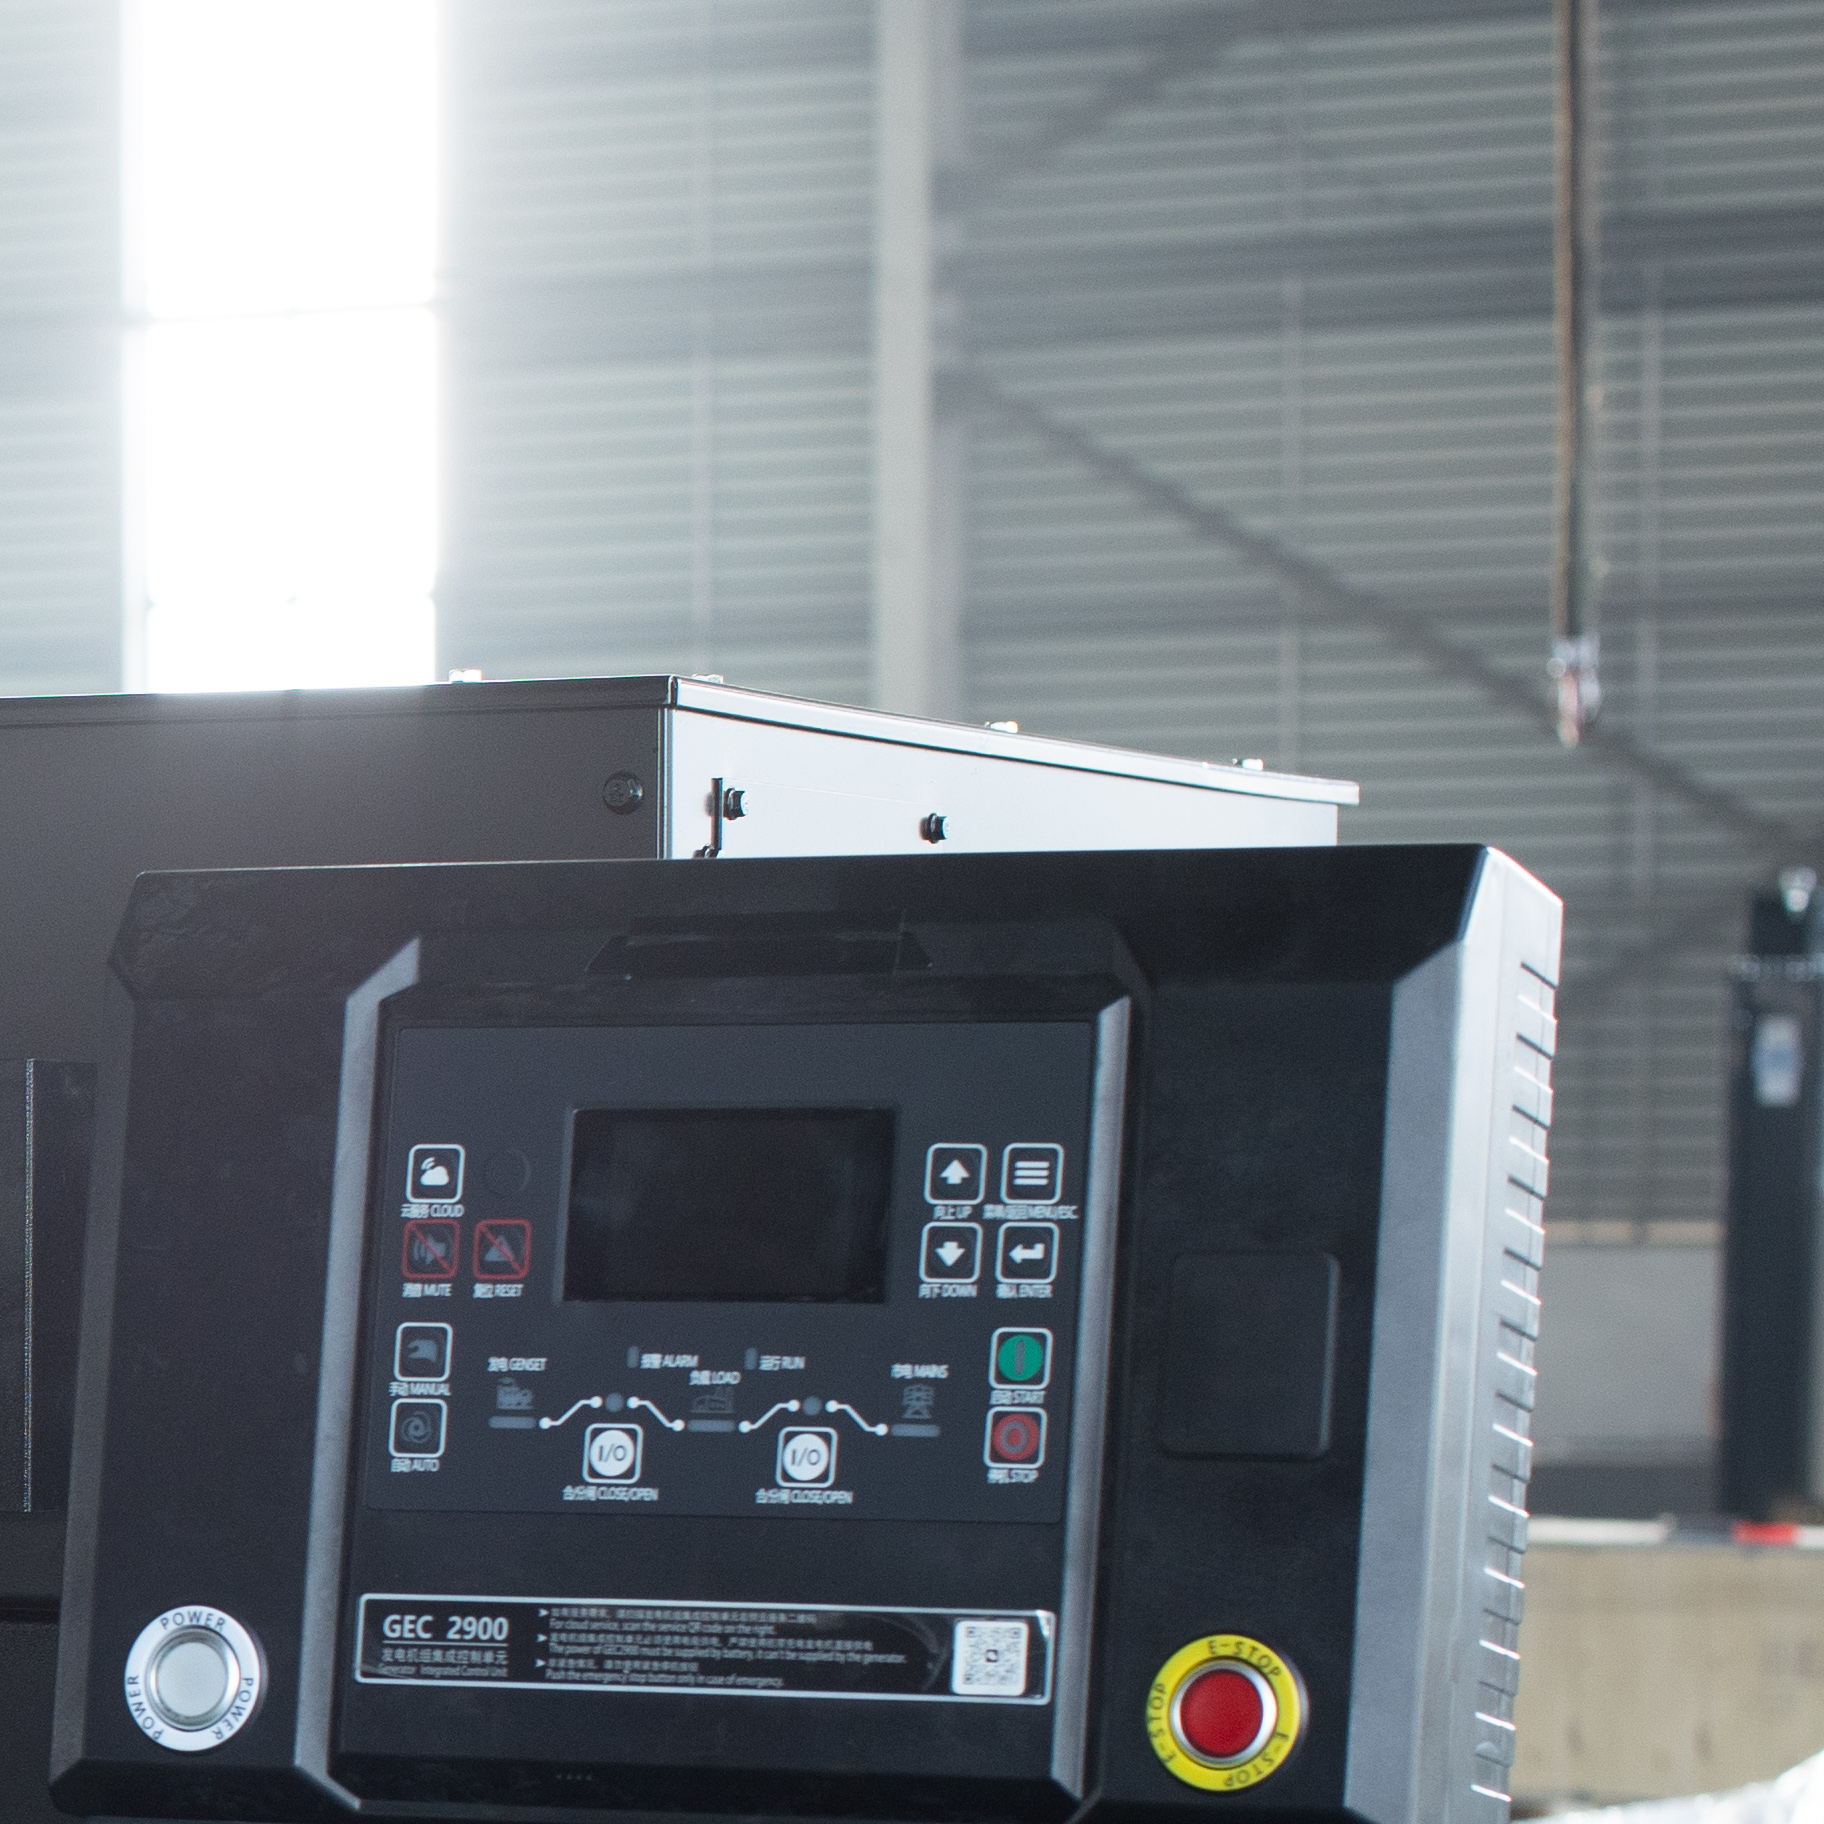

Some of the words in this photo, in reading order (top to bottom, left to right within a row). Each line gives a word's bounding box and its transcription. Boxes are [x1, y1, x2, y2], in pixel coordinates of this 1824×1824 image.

[430, 1204, 465, 1217] CLOUD
[956, 1206, 973, 1219] UP
[423, 1283, 453, 1297] MUTE
[495, 1284, 524, 1297] RESET
[942, 1284, 977, 1297] DOWN
[1018, 1284, 1053, 1298] ENTER
[509, 1357, 547, 1371] GENSET
[662, 1354, 699, 1368] ALARM
[781, 1356, 806, 1370] RUN
[711, 1371, 742, 1385] LOAD
[914, 1364, 949, 1378] MAINS
[410, 1382, 451, 1396] MANUAL
[1012, 1391, 1046, 1404] START
[412, 1459, 440, 1472] AUTO
[1009, 1470, 1040, 1484] STOP
[160, 1610, 226, 1631] POWER
[382, 1614, 433, 1639] GEC
[446, 1615, 509, 1641] 2900
[1207, 1639, 1282, 1678] E-STOP
[127, 1675, 164, 1741] POWER
[212, 1677, 255, 1741] POWER
